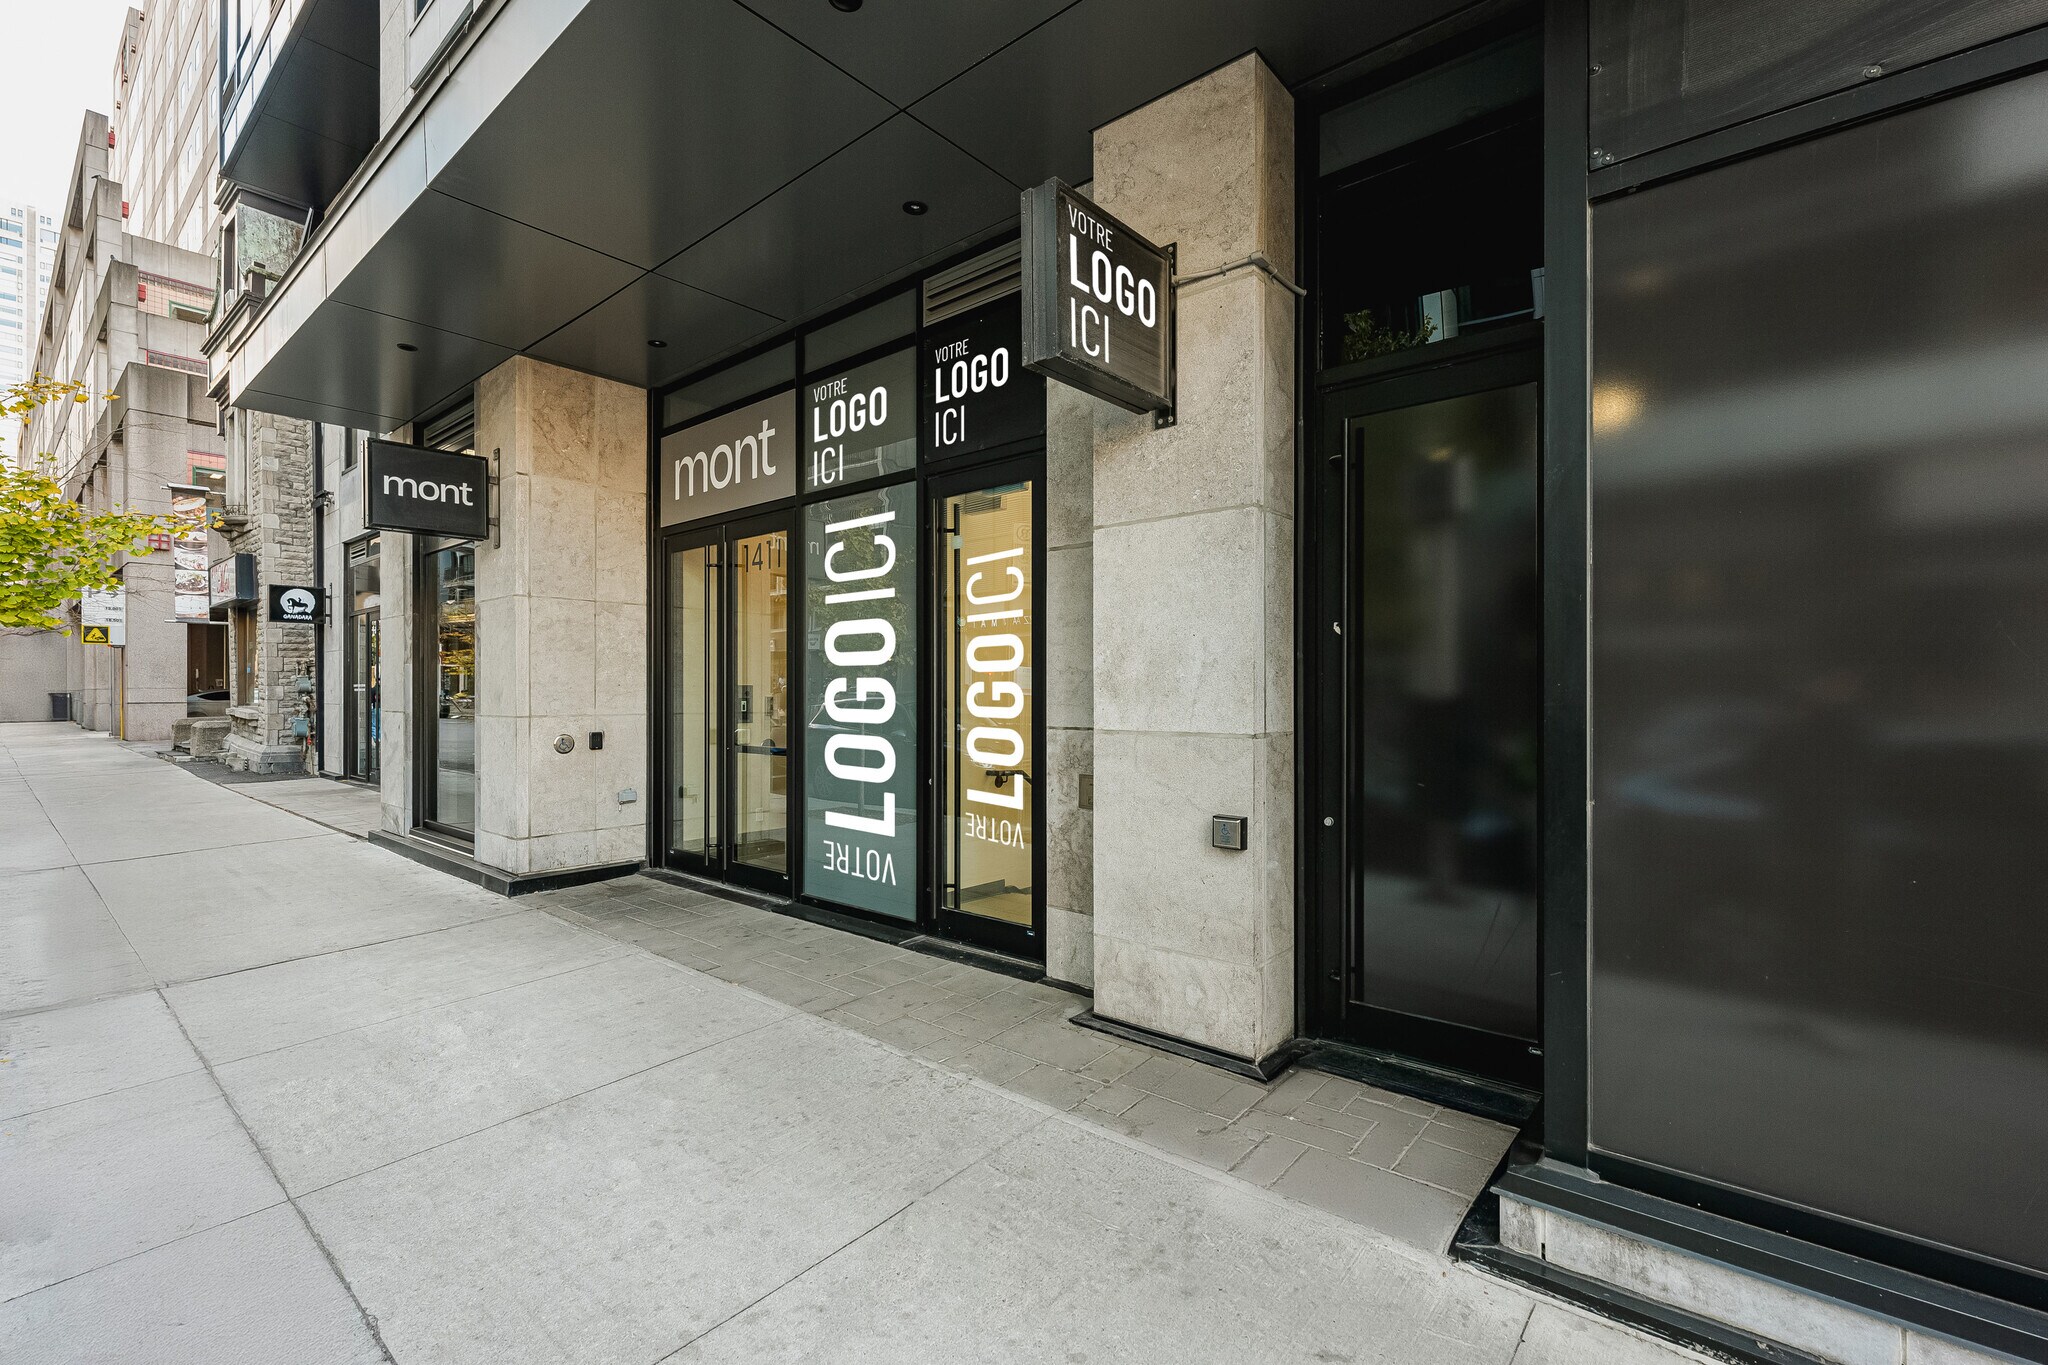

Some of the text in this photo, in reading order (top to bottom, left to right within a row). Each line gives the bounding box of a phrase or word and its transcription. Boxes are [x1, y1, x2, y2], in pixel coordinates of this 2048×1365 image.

[1068, 204, 1114, 253] VOTRE
[1069, 233, 1156, 328] LOGO
[935, 338, 969, 364] VOTRE
[1070, 296, 1110, 364] ICI
[812, 377, 848, 403] VOTRE
[935, 347, 1009, 404] LOGO
[812, 386, 887, 443] LOGO
[935, 405, 966, 448] ICI
[674, 419, 777, 501] mont
[812, 445, 844, 487] ICI
[383, 474, 474, 507] mont
[743, 539, 781, 573] 1411
[282, 613, 313, 621] GANADARA
[965, 812, 1025, 851] VOTRE
[822, 840, 897, 886] VOTRE
